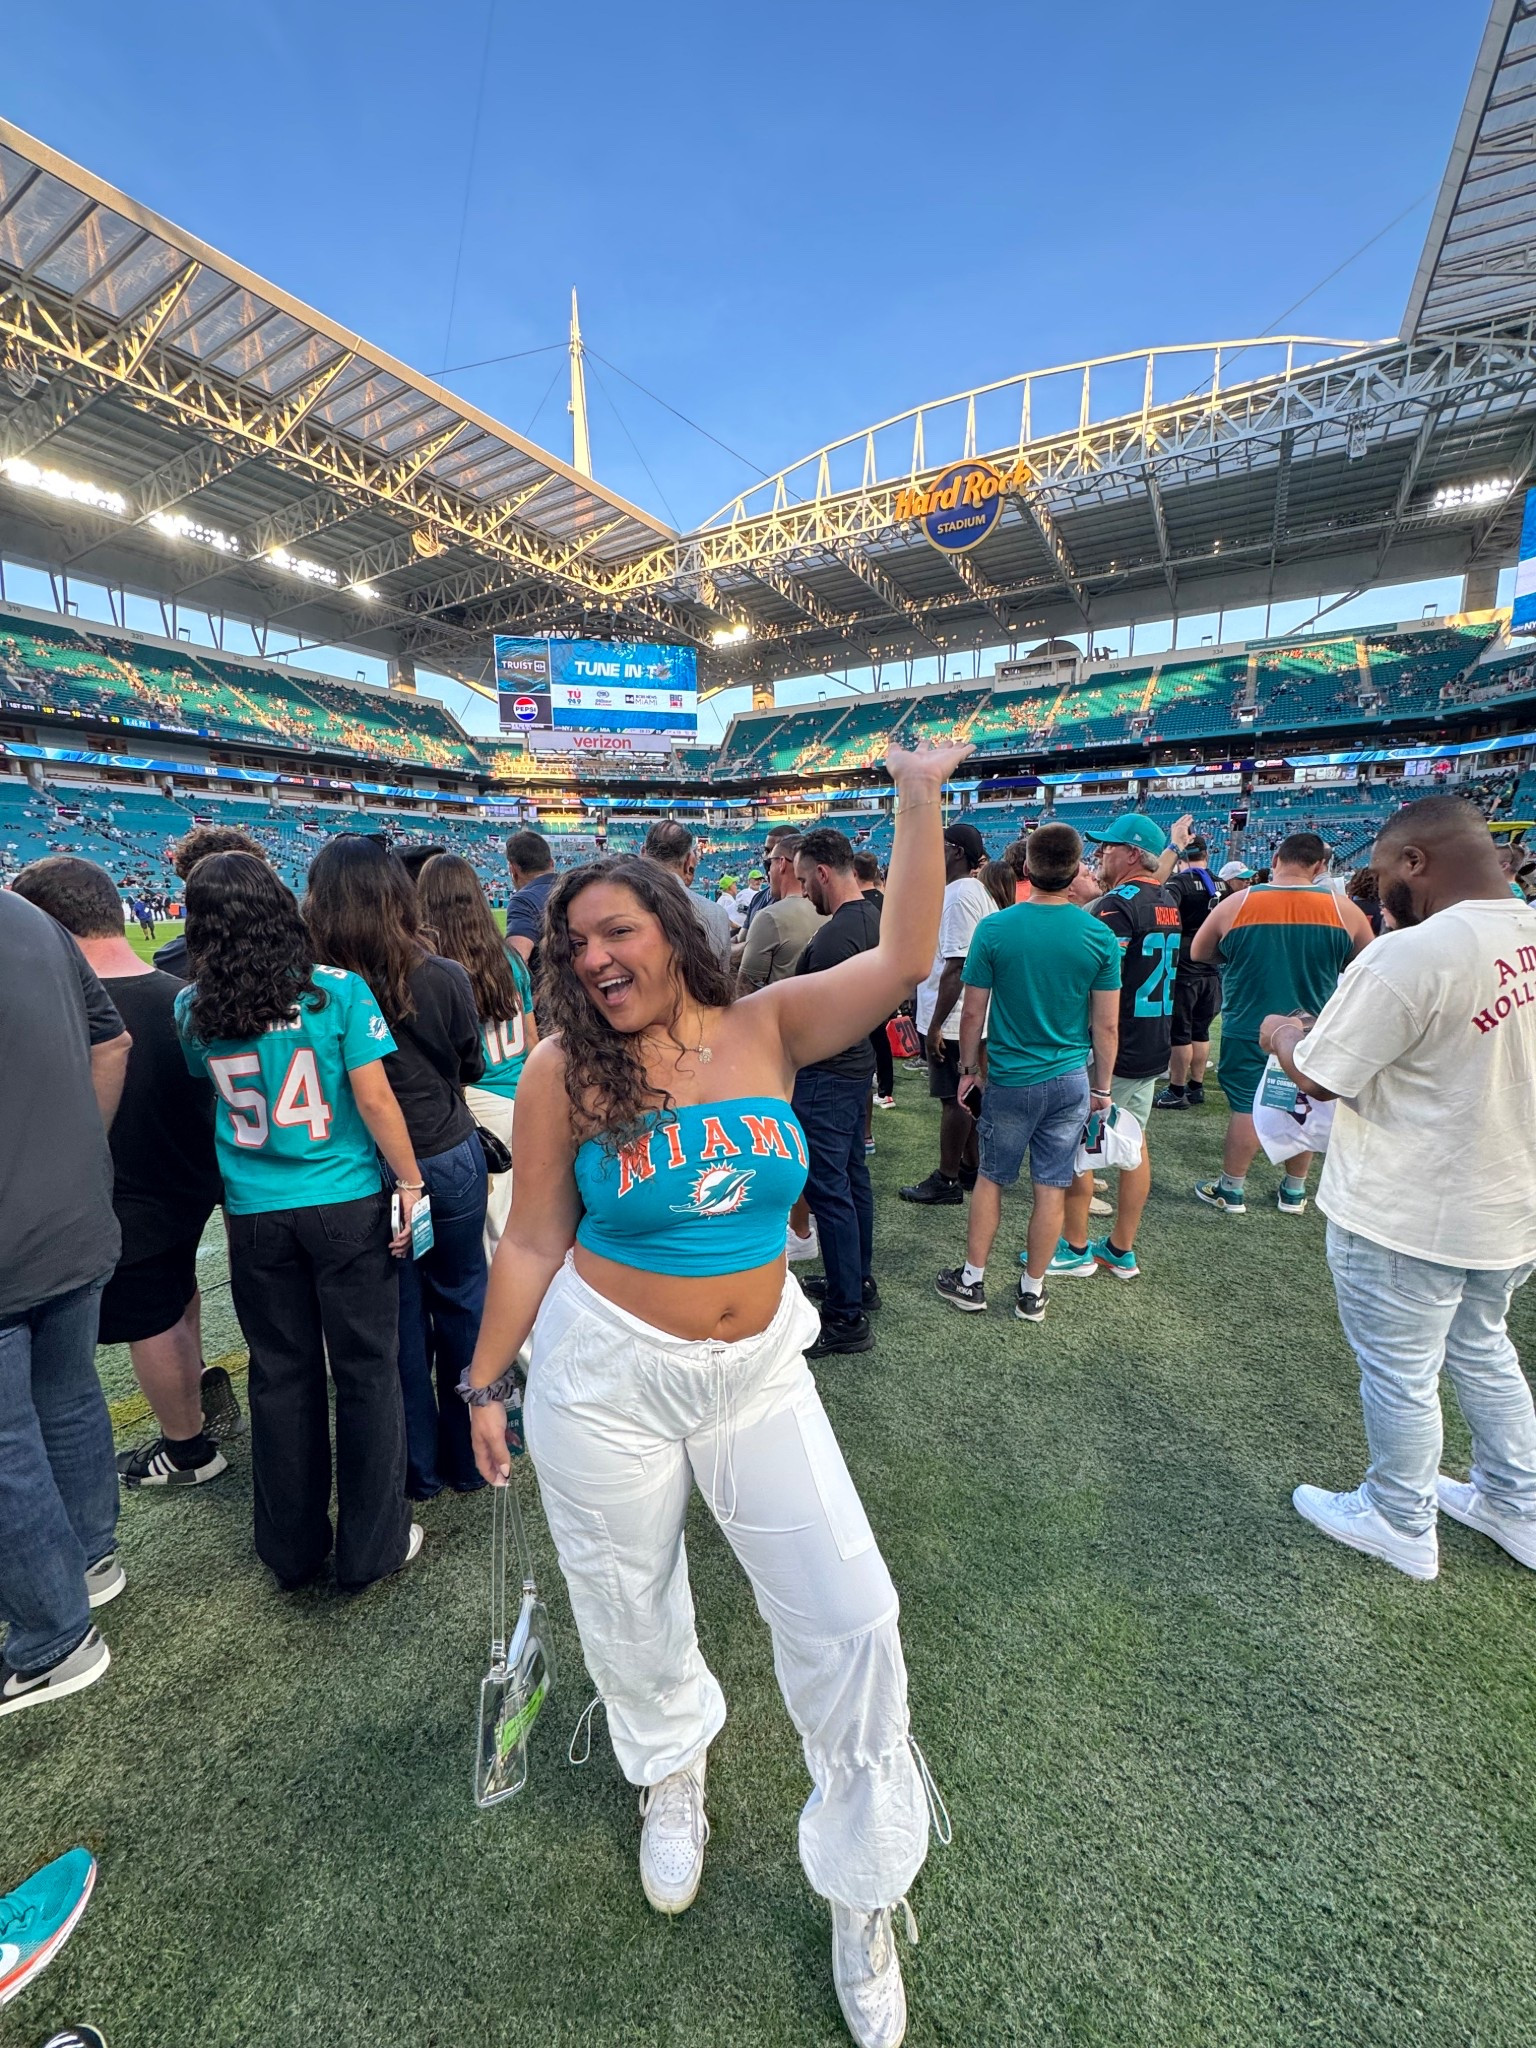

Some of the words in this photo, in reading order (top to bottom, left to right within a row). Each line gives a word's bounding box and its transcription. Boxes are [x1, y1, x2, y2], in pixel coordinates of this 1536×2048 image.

[894, 475, 962, 521] Hard
[962, 460, 1032, 509] Rock
[937, 514, 986, 534] STADIUM
[501, 661, 533, 670] TRUIST
[574, 661, 620, 678] TUNE
[624, 663, 642, 679] IN
[573, 734, 632, 750] verizon
[208, 1047, 333, 1149] 54
[618, 1115, 808, 1198] MIAMI
[956, 1285, 973, 1297] HOKA
